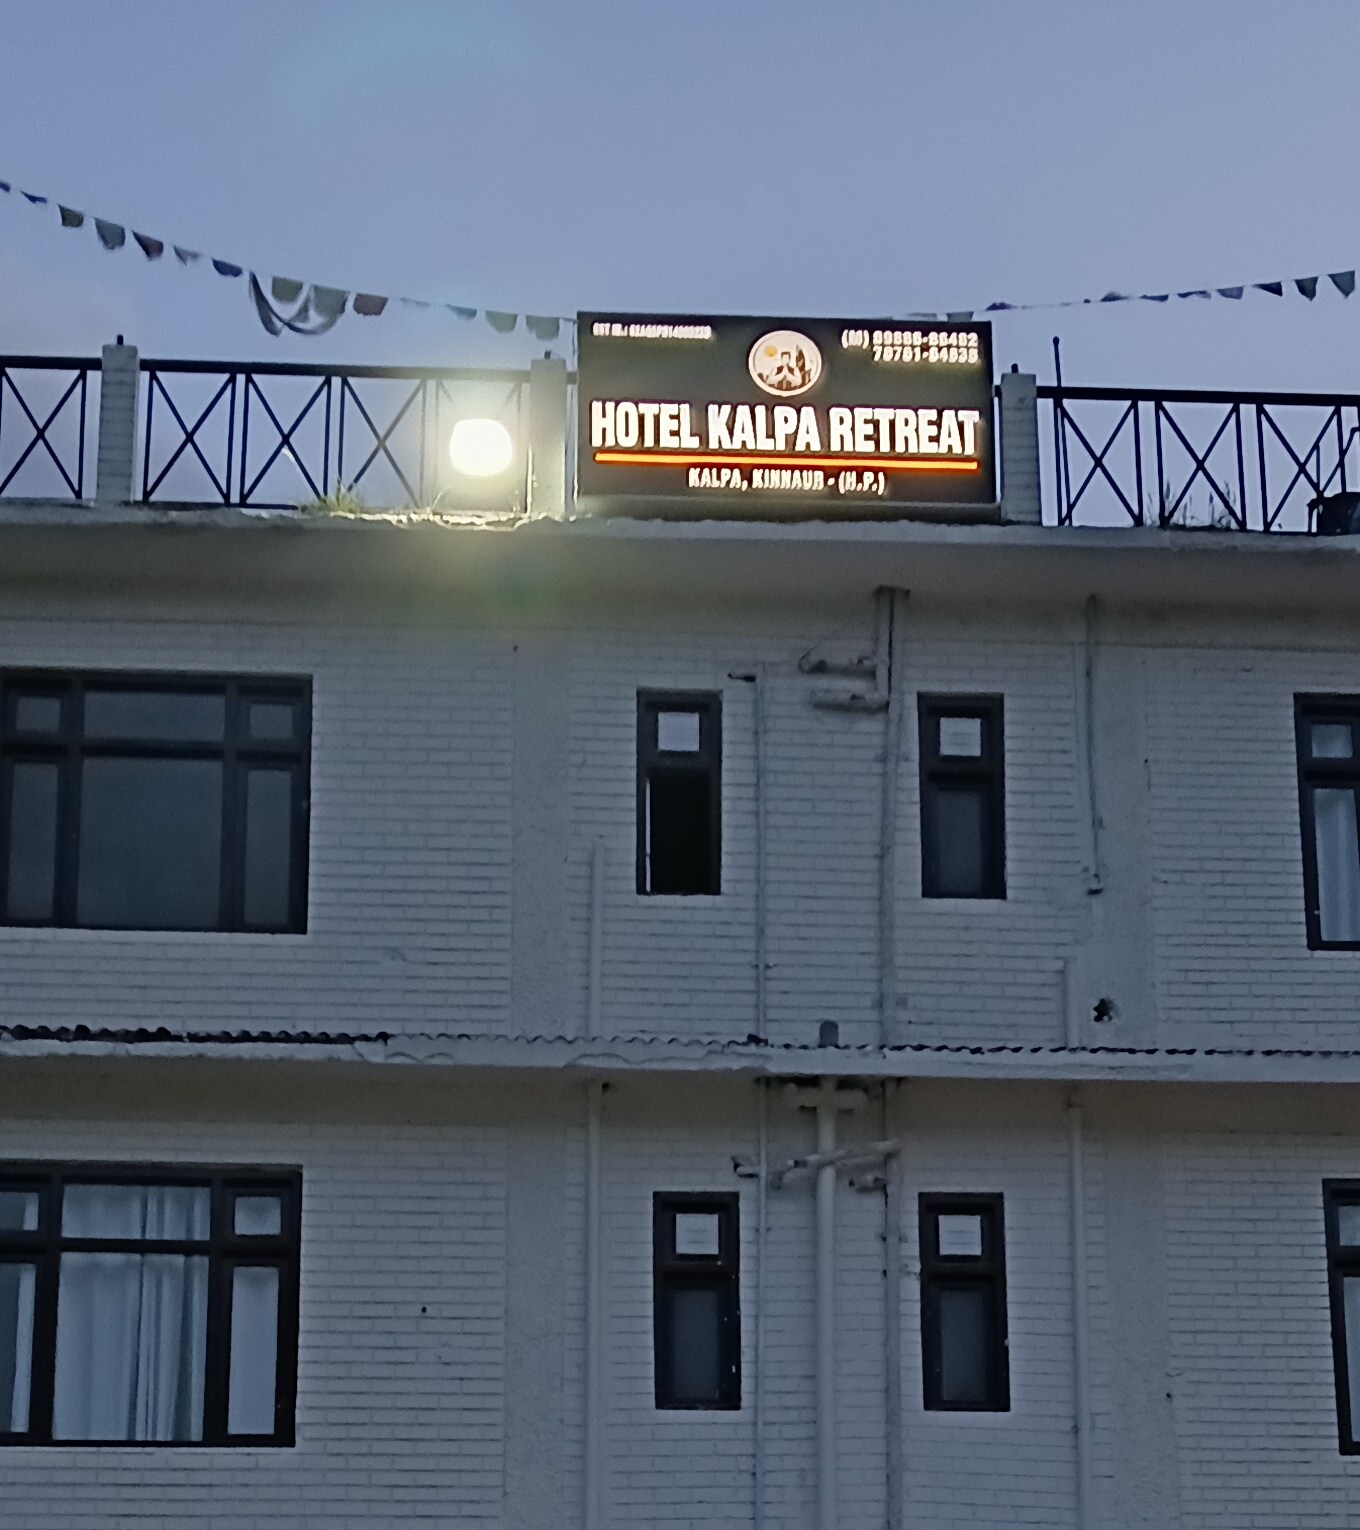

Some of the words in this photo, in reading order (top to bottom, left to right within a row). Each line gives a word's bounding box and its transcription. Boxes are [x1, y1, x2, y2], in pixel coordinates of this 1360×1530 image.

[591, 401, 700, 449] HOTEL
[707, 404, 822, 452] KALPA
[829, 407, 980, 456] RETREAT
[688, 467, 748, 491] KALPA,
